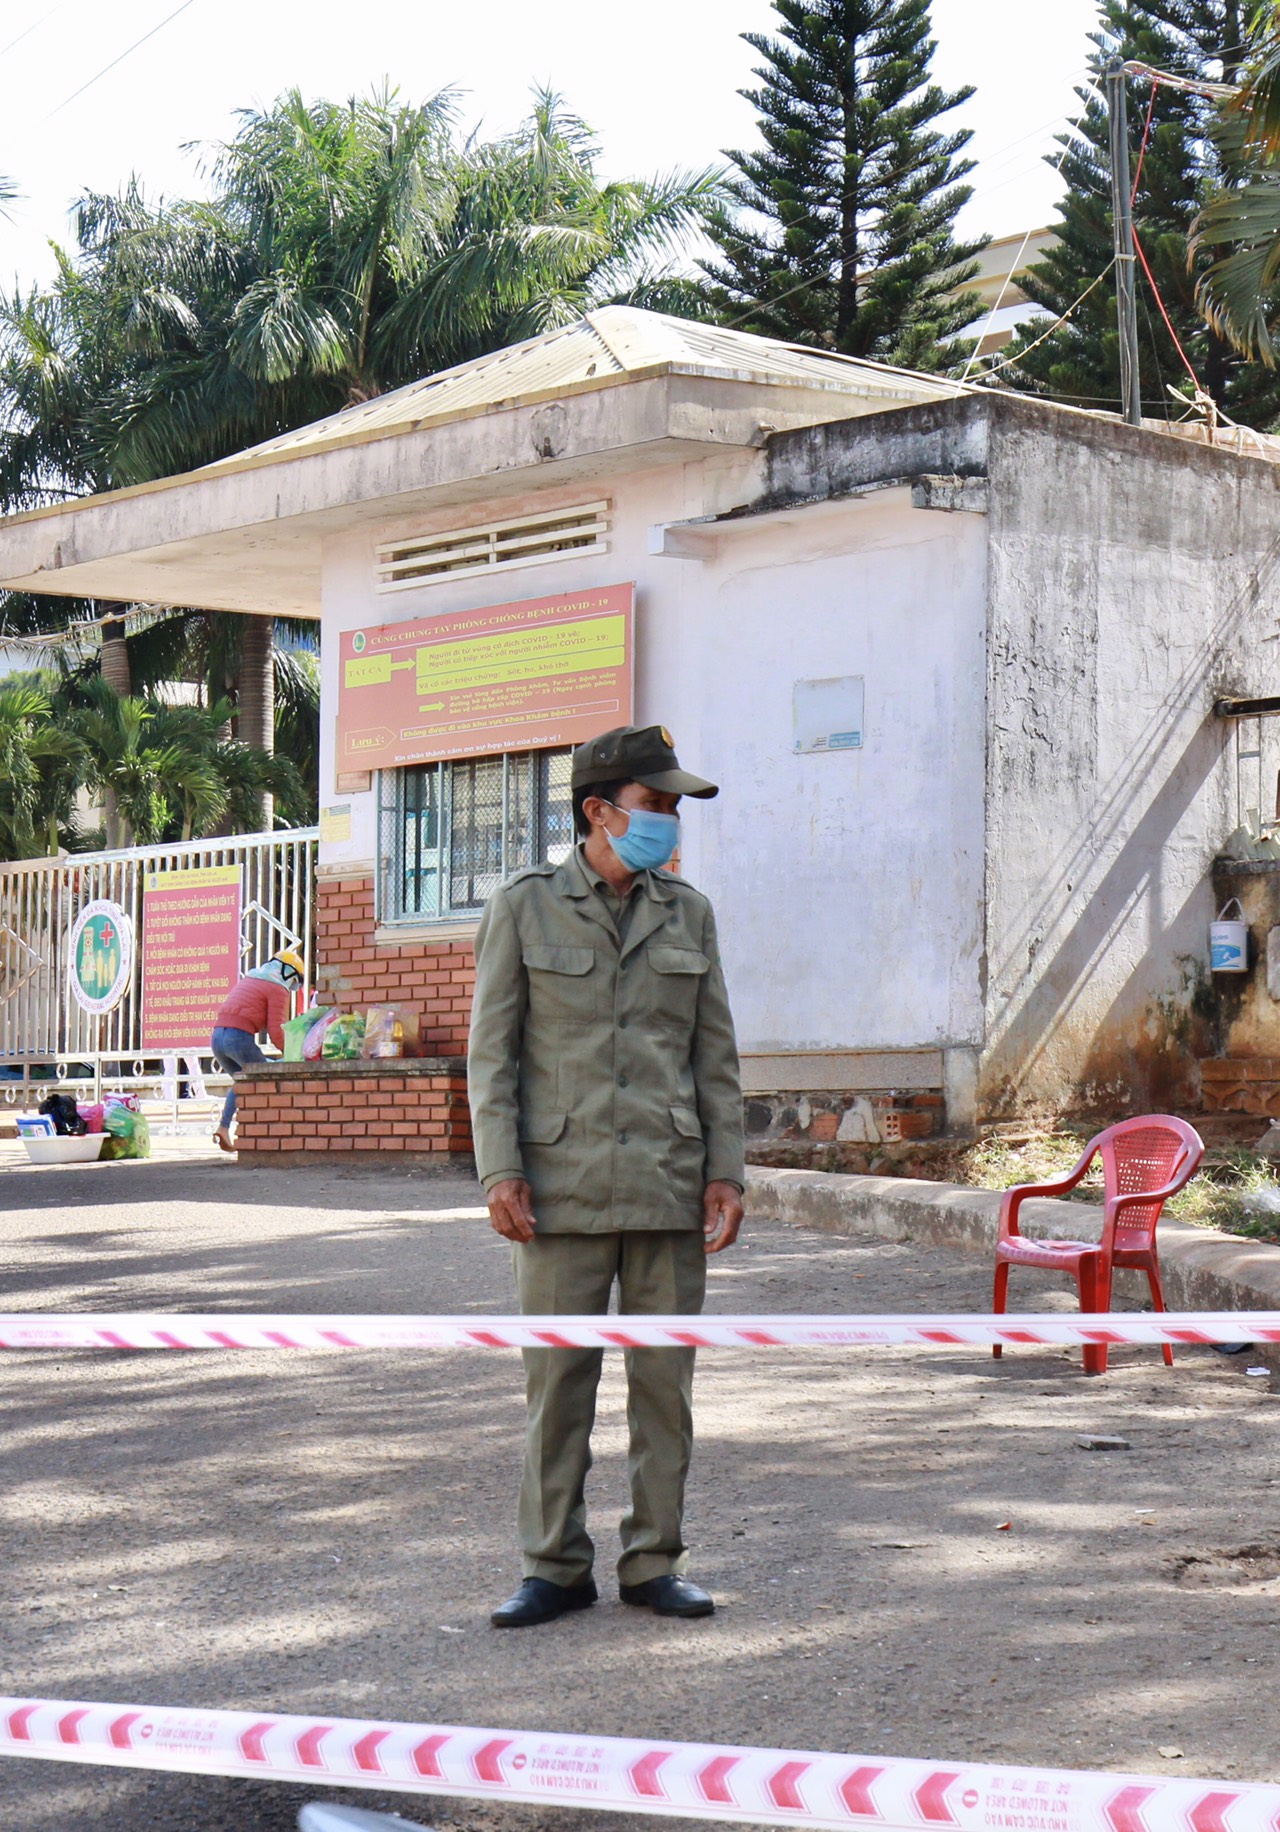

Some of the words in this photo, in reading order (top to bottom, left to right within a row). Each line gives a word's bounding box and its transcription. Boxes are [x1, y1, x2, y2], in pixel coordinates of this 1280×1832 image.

[398, 628, 432, 640] CHUNG
[434, 625, 450, 634] TAY
[452, 617, 487, 630] PHÒNG
[527, 607, 555, 620] BỆNH
[556, 601, 590, 614] COVID
[598, 598, 609, 606] 19
[521, 635, 548, 645] COVID
[559, 637, 586, 647] COVID
